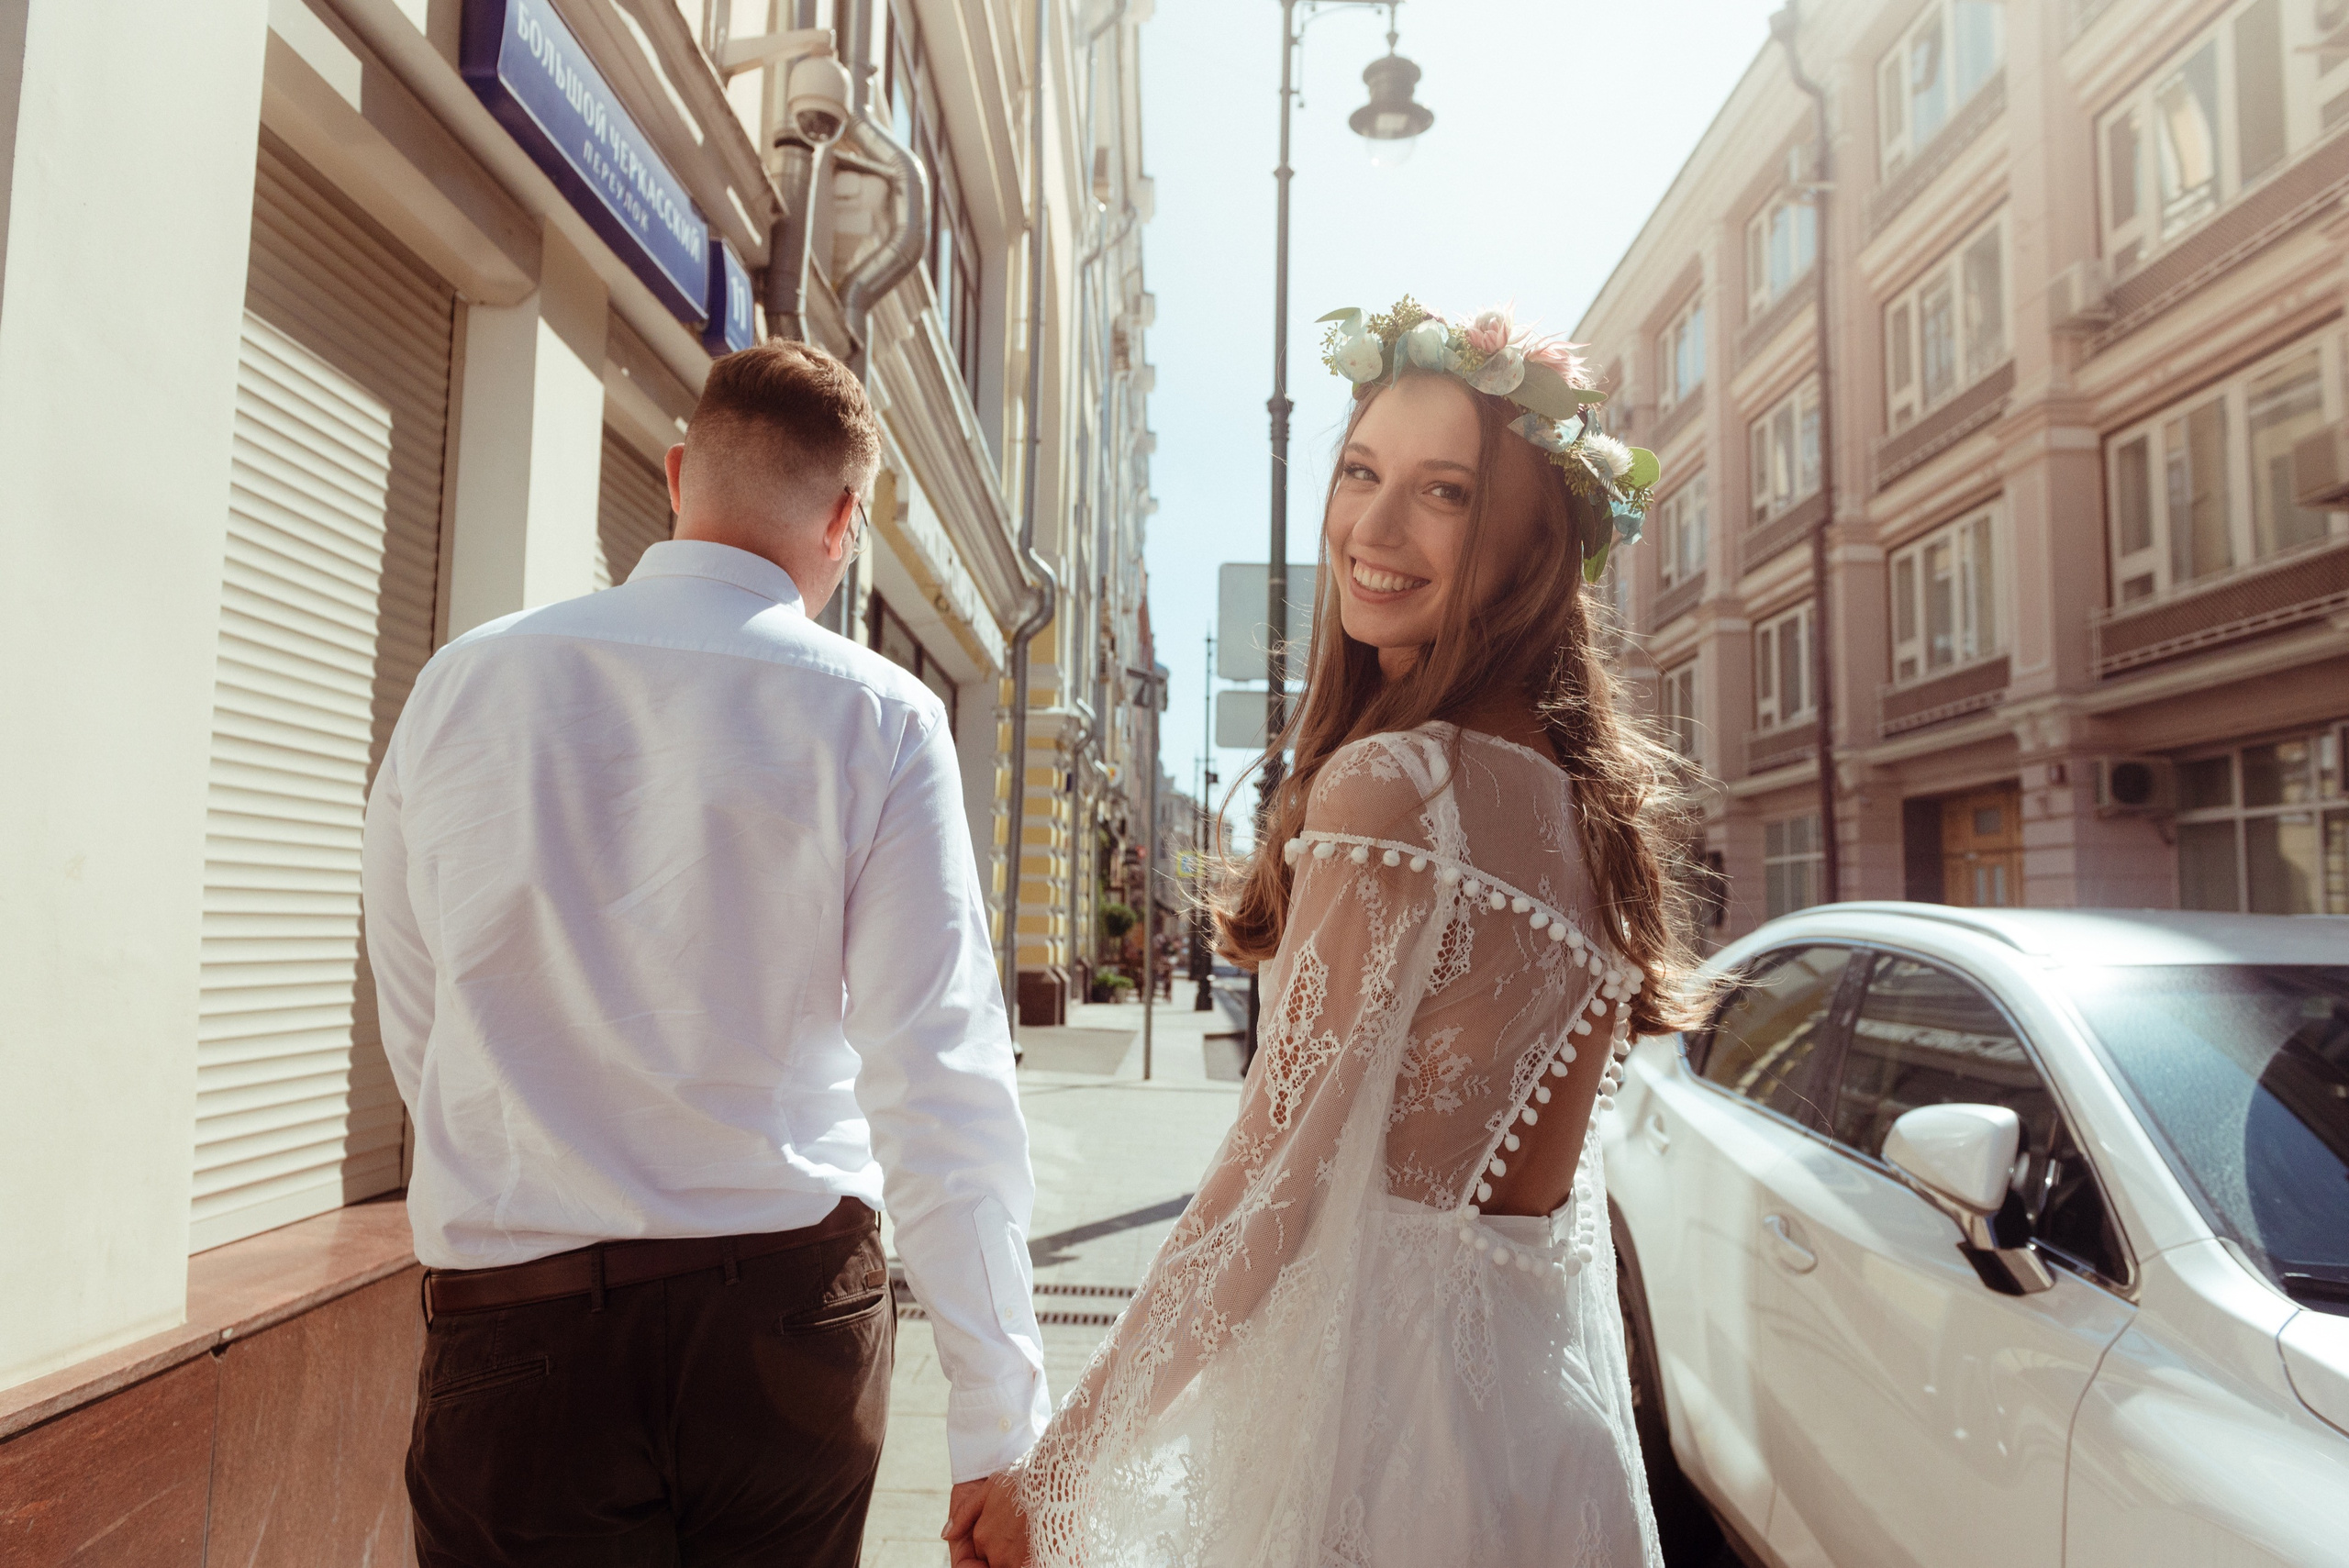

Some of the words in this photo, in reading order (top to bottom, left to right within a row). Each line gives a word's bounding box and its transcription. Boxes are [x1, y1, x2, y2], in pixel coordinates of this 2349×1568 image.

[518, 3, 607, 145] БОЛЬШОЙ
[609, 125, 701, 264] ЧЕРКАССКИЙ
[584, 139, 650, 232] ПЕРЕУЛОК
